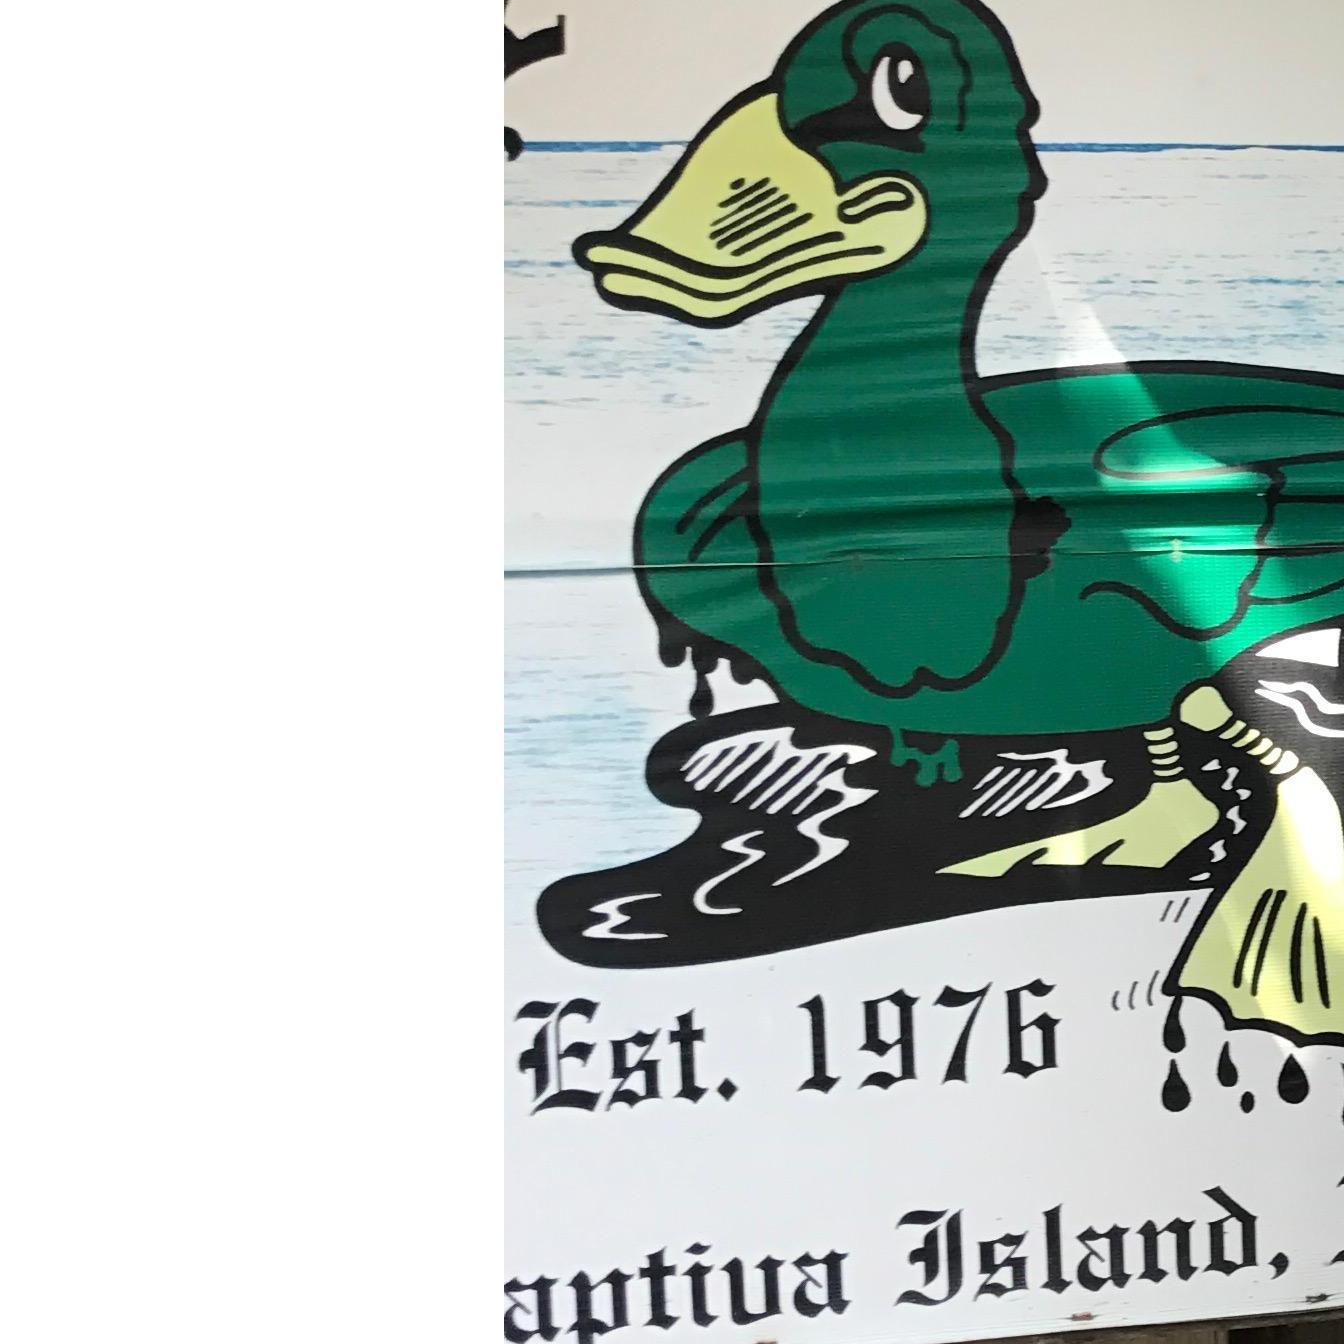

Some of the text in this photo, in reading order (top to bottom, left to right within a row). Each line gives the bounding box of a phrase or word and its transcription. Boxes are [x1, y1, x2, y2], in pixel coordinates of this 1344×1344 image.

[514, 978, 1062, 1116] Est. 1976
[894, 1186, 1290, 1307] Island,
